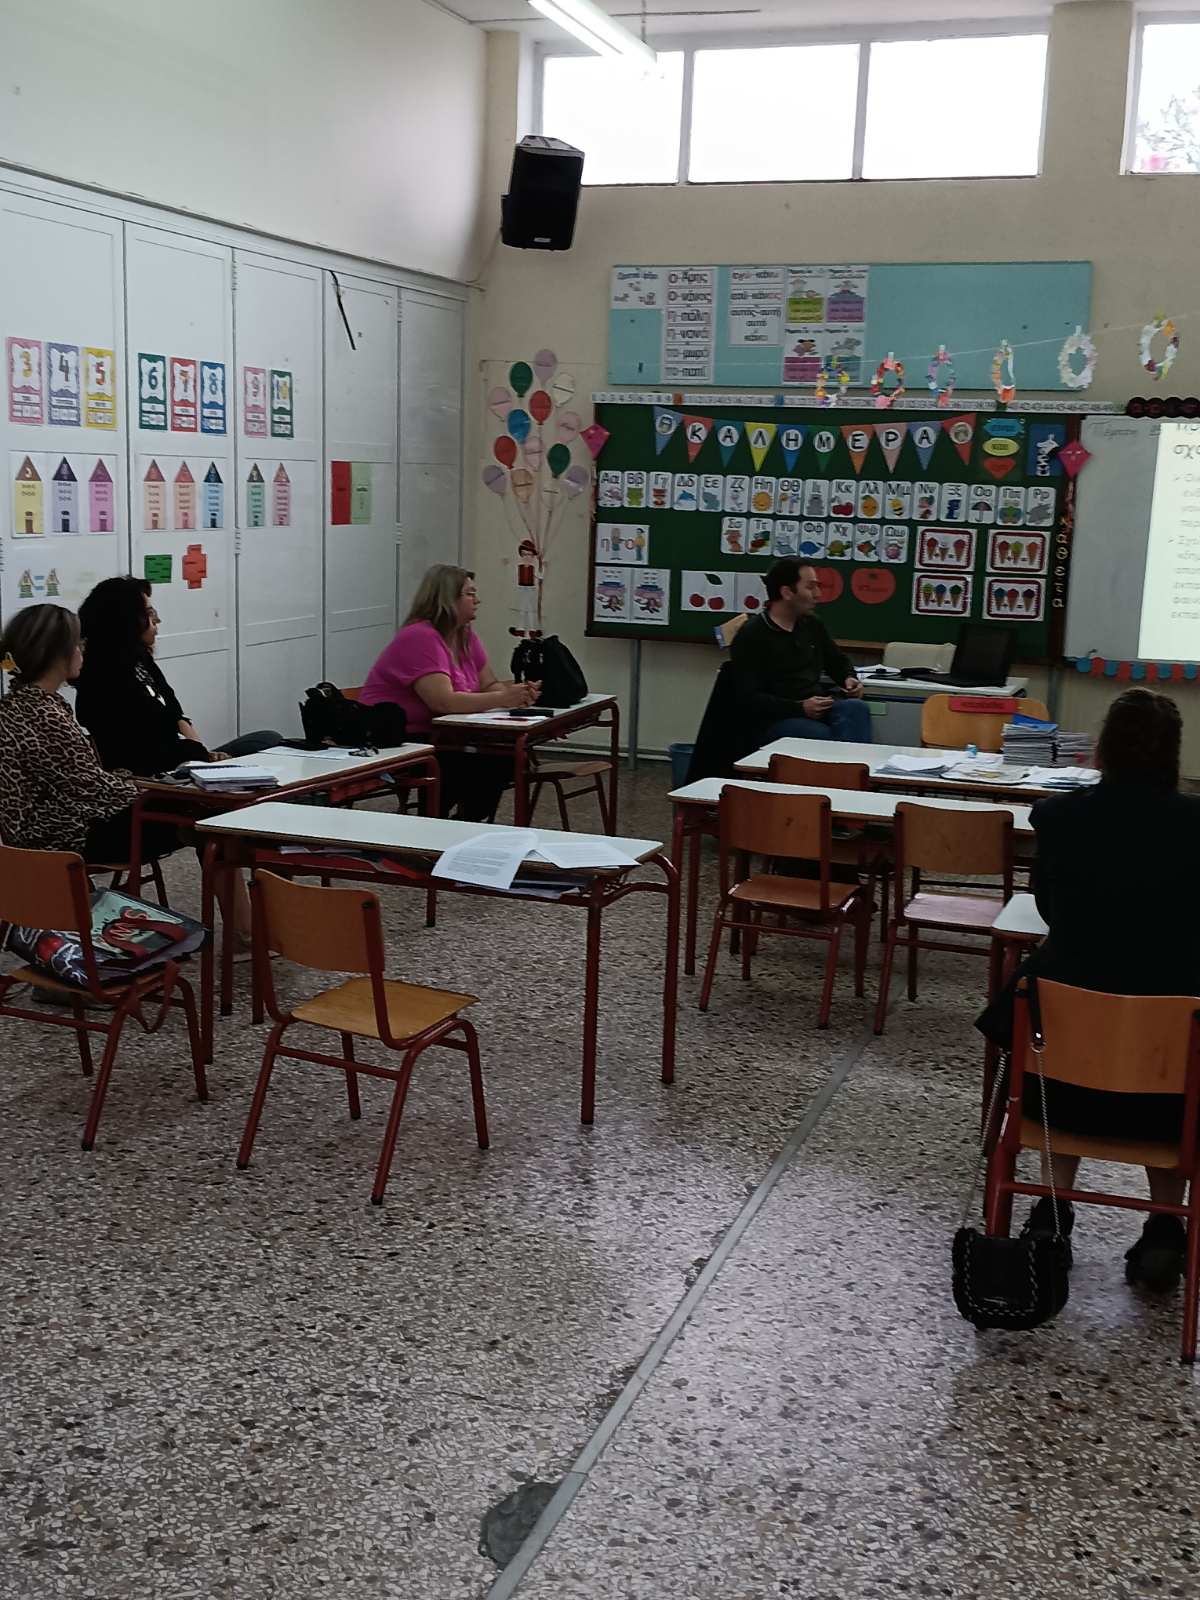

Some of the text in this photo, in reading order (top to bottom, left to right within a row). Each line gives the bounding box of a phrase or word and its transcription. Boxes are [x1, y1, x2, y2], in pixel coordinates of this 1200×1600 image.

[22, 351, 32, 378] 3
[59, 355, 69, 382] 4
[95, 361, 106, 386] 5
[148, 367, 159, 390] 6
[179, 369, 190, 393] 7
[209, 372, 218, 395] 8
[601, 473, 619, 484] Αα
[626, 473, 643, 486] Ββ
[654, 474, 667, 488] Γγ
[676, 475, 694, 487] Δδ
[704, 476, 719, 488] Εε
[754, 479, 771, 493] Ηη
[779, 480, 800, 492] Θθ
[835, 482, 852, 493] Κκ
[861, 483, 880, 494] Λλ
[888, 483, 911, 496] Μμ
[974, 486, 992, 496] Οο
[1033, 489, 1049, 500] Ρρ
[728, 519, 742, 528] Σσ
[755, 520, 767, 530] Ττ
[781, 522, 794, 532] Υυ
[804, 523, 823, 534] Φφ
[834, 524, 848, 536] Χχ
[885, 527, 905, 537] Ωω
